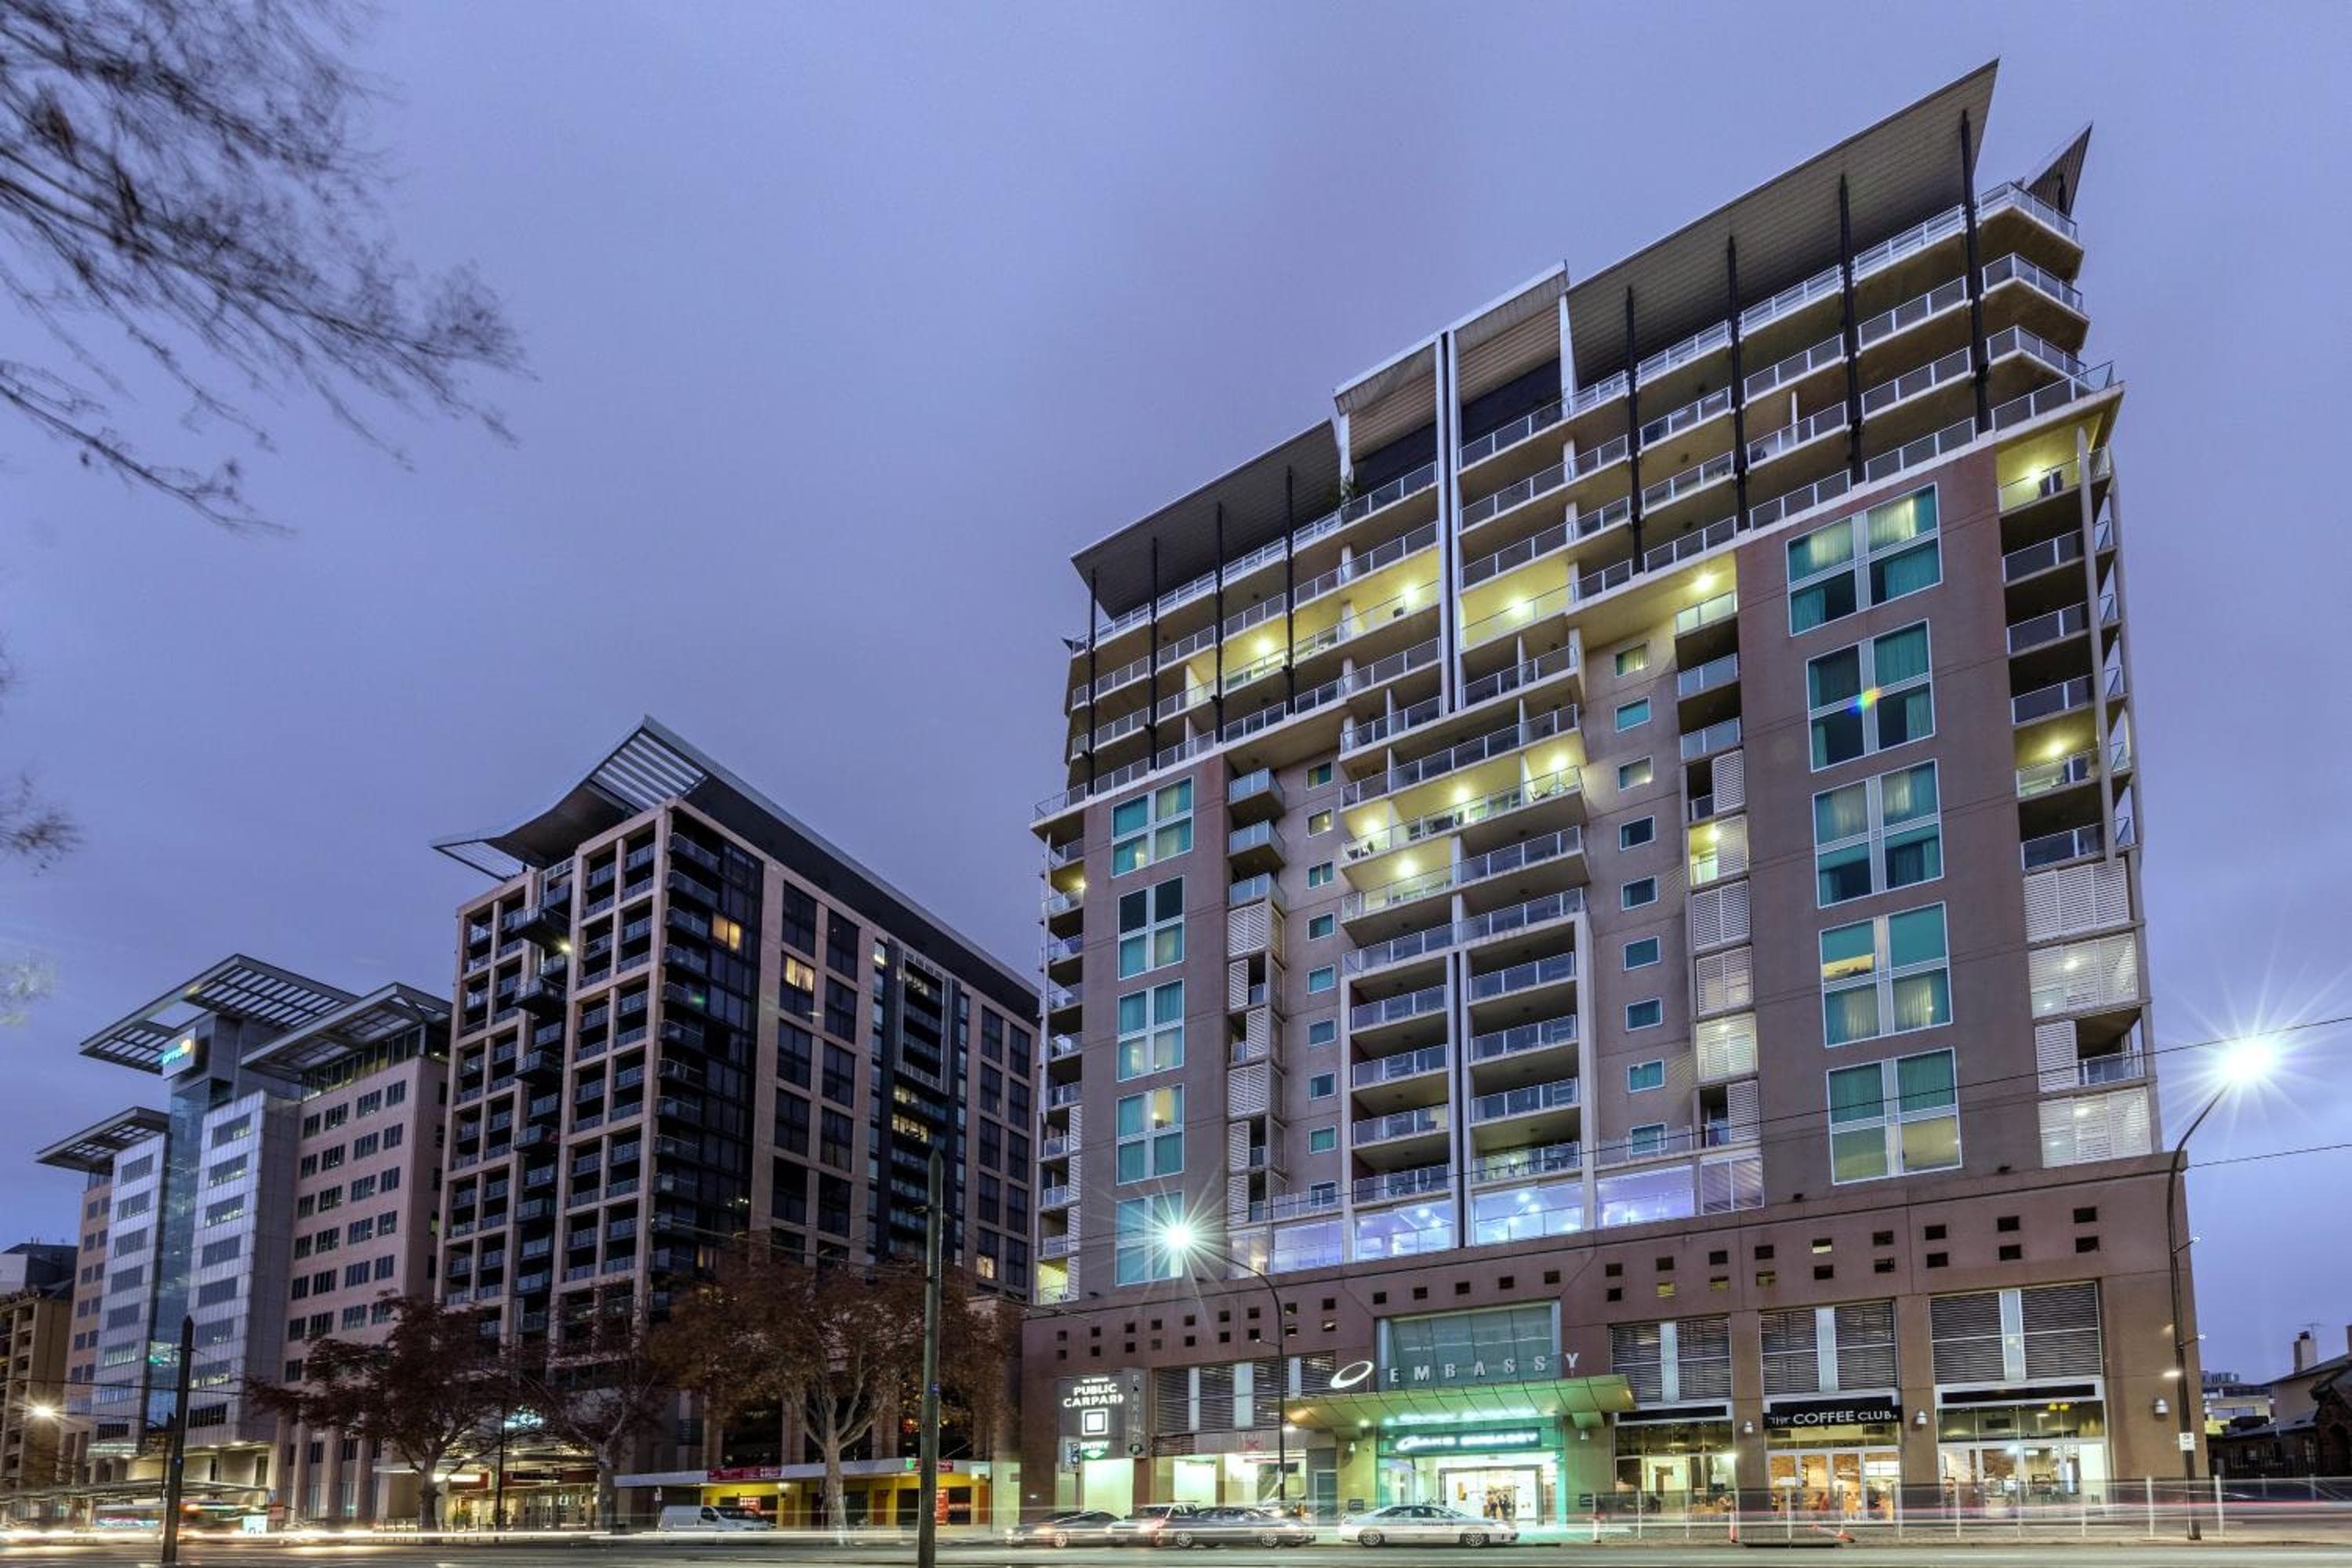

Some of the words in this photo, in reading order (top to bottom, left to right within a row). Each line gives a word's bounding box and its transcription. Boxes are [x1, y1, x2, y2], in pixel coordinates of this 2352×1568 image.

[1389, 1352, 1579, 1383] EMBASSY
[1073, 1383, 1117, 1396] PUBLIC
[1793, 1411, 1855, 1425] COFFEE
